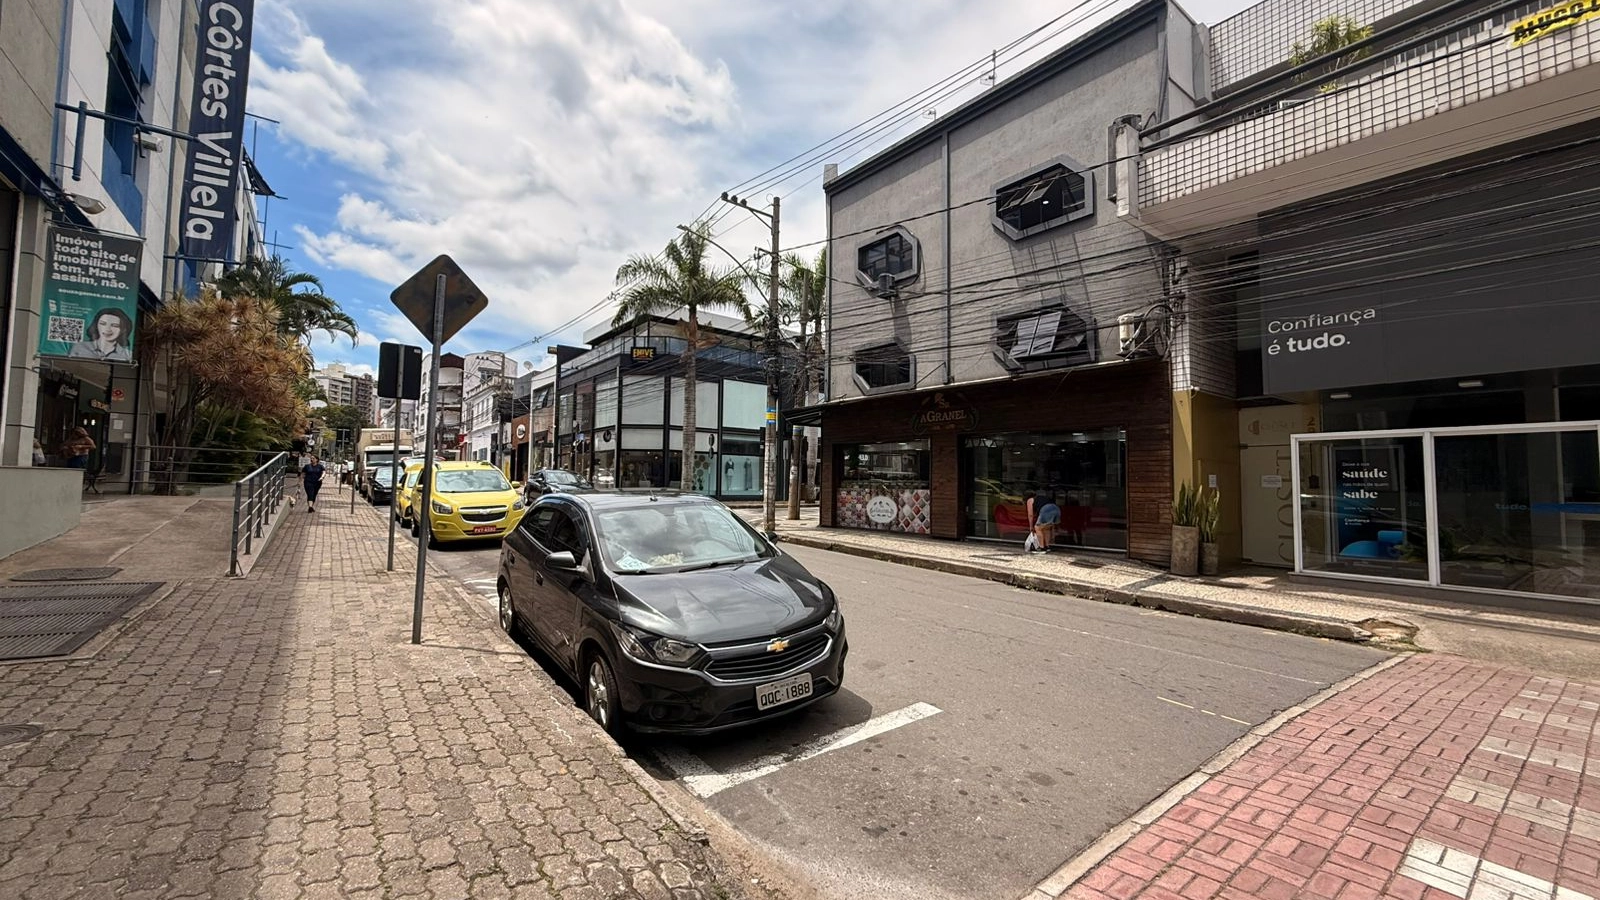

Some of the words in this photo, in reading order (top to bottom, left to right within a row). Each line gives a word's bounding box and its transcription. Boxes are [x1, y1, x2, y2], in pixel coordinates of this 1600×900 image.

[200, 1, 243, 120] Côrtes
[185, 131, 233, 241] Villela
[55, 233, 102, 249] Imóvel
[53, 251, 127, 271] imobiliária
[55, 243, 88, 255] todo
[91, 249, 117, 260] site
[120, 253, 136, 264] de
[52, 262, 86, 275] tem.
[88, 266, 116, 279] Mas
[51, 272, 98, 287] assim,
[101, 277, 129, 290] não.
[1267, 308, 1376, 334] Confiança
[1267, 339, 1281, 355] é
[1286, 332, 1351, 353] tudo.
[1342, 468, 1388, 478] saúde
[1343, 489, 1378, 499] sabe
